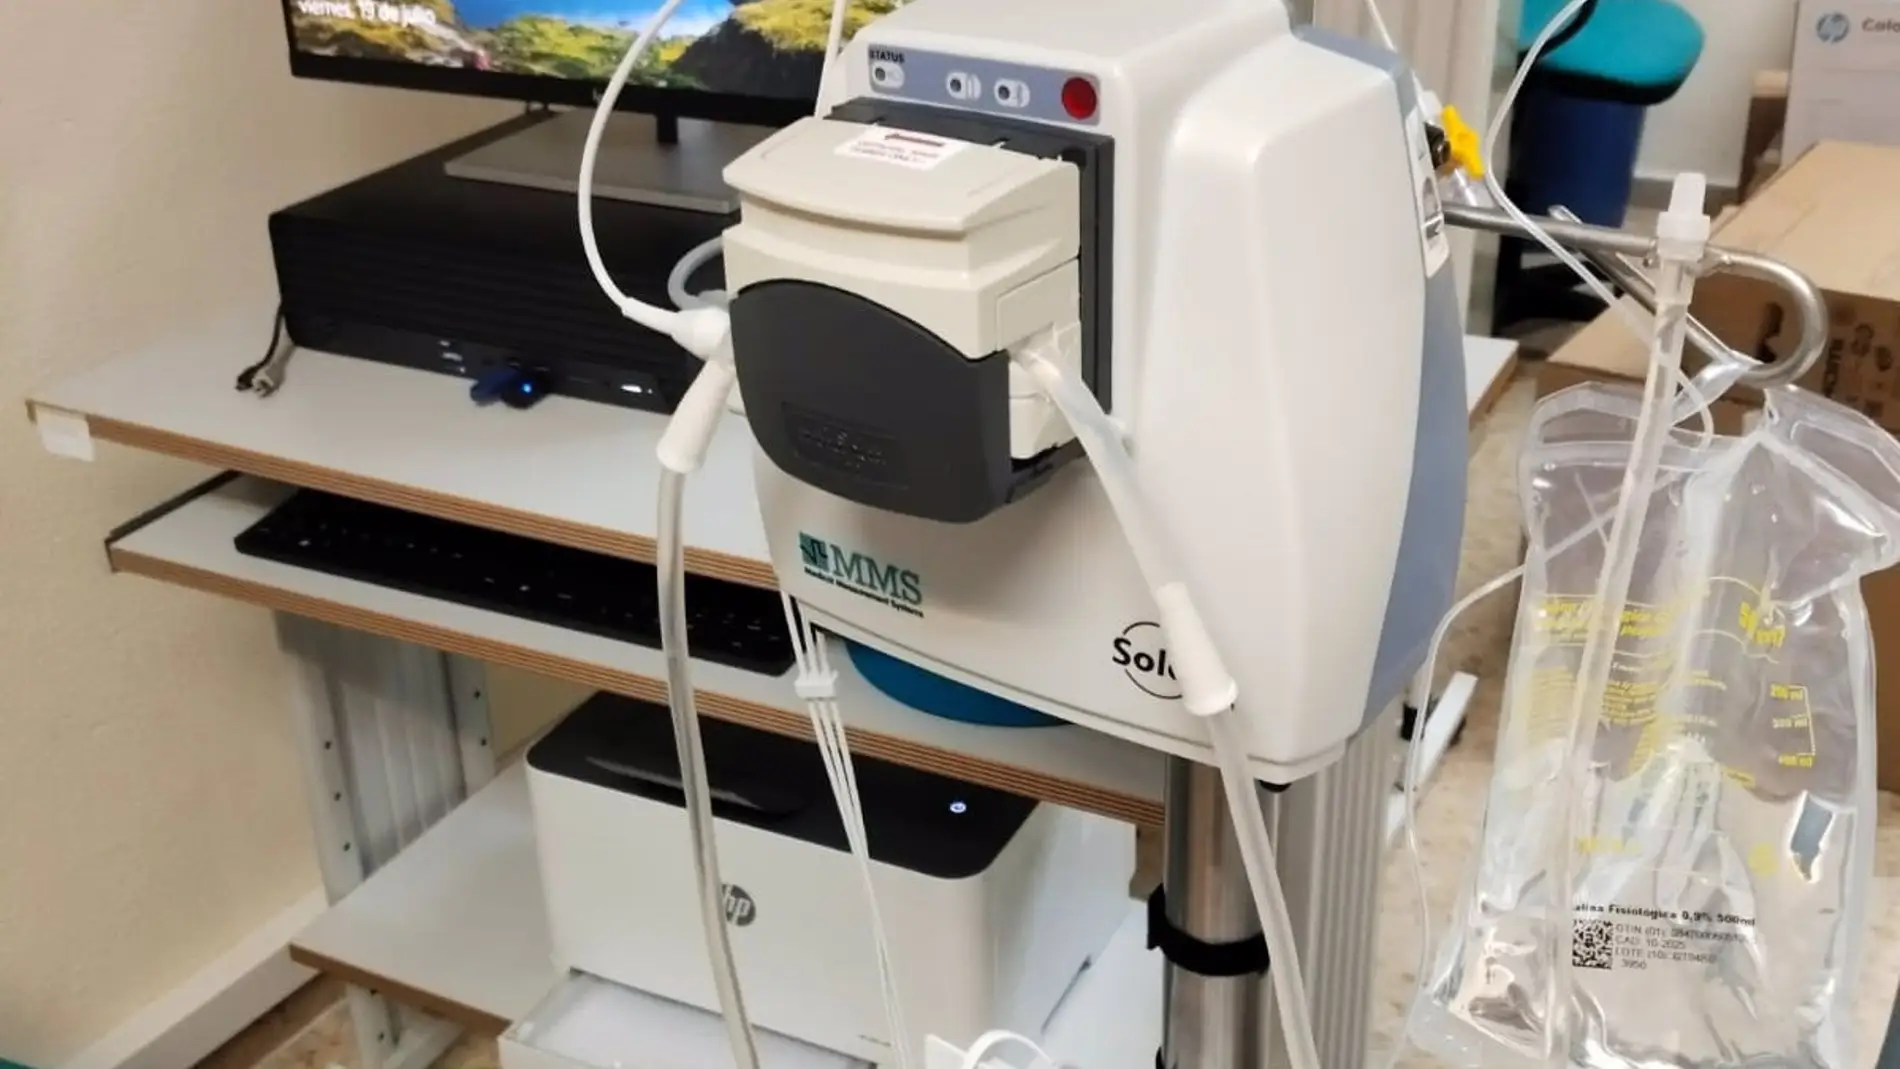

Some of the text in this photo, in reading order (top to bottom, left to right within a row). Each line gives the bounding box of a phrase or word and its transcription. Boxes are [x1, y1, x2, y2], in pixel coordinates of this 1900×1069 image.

[378, 2, 399, 23] de
[869, 50, 905, 63] STATUS
[830, 544, 922, 605] MMS
